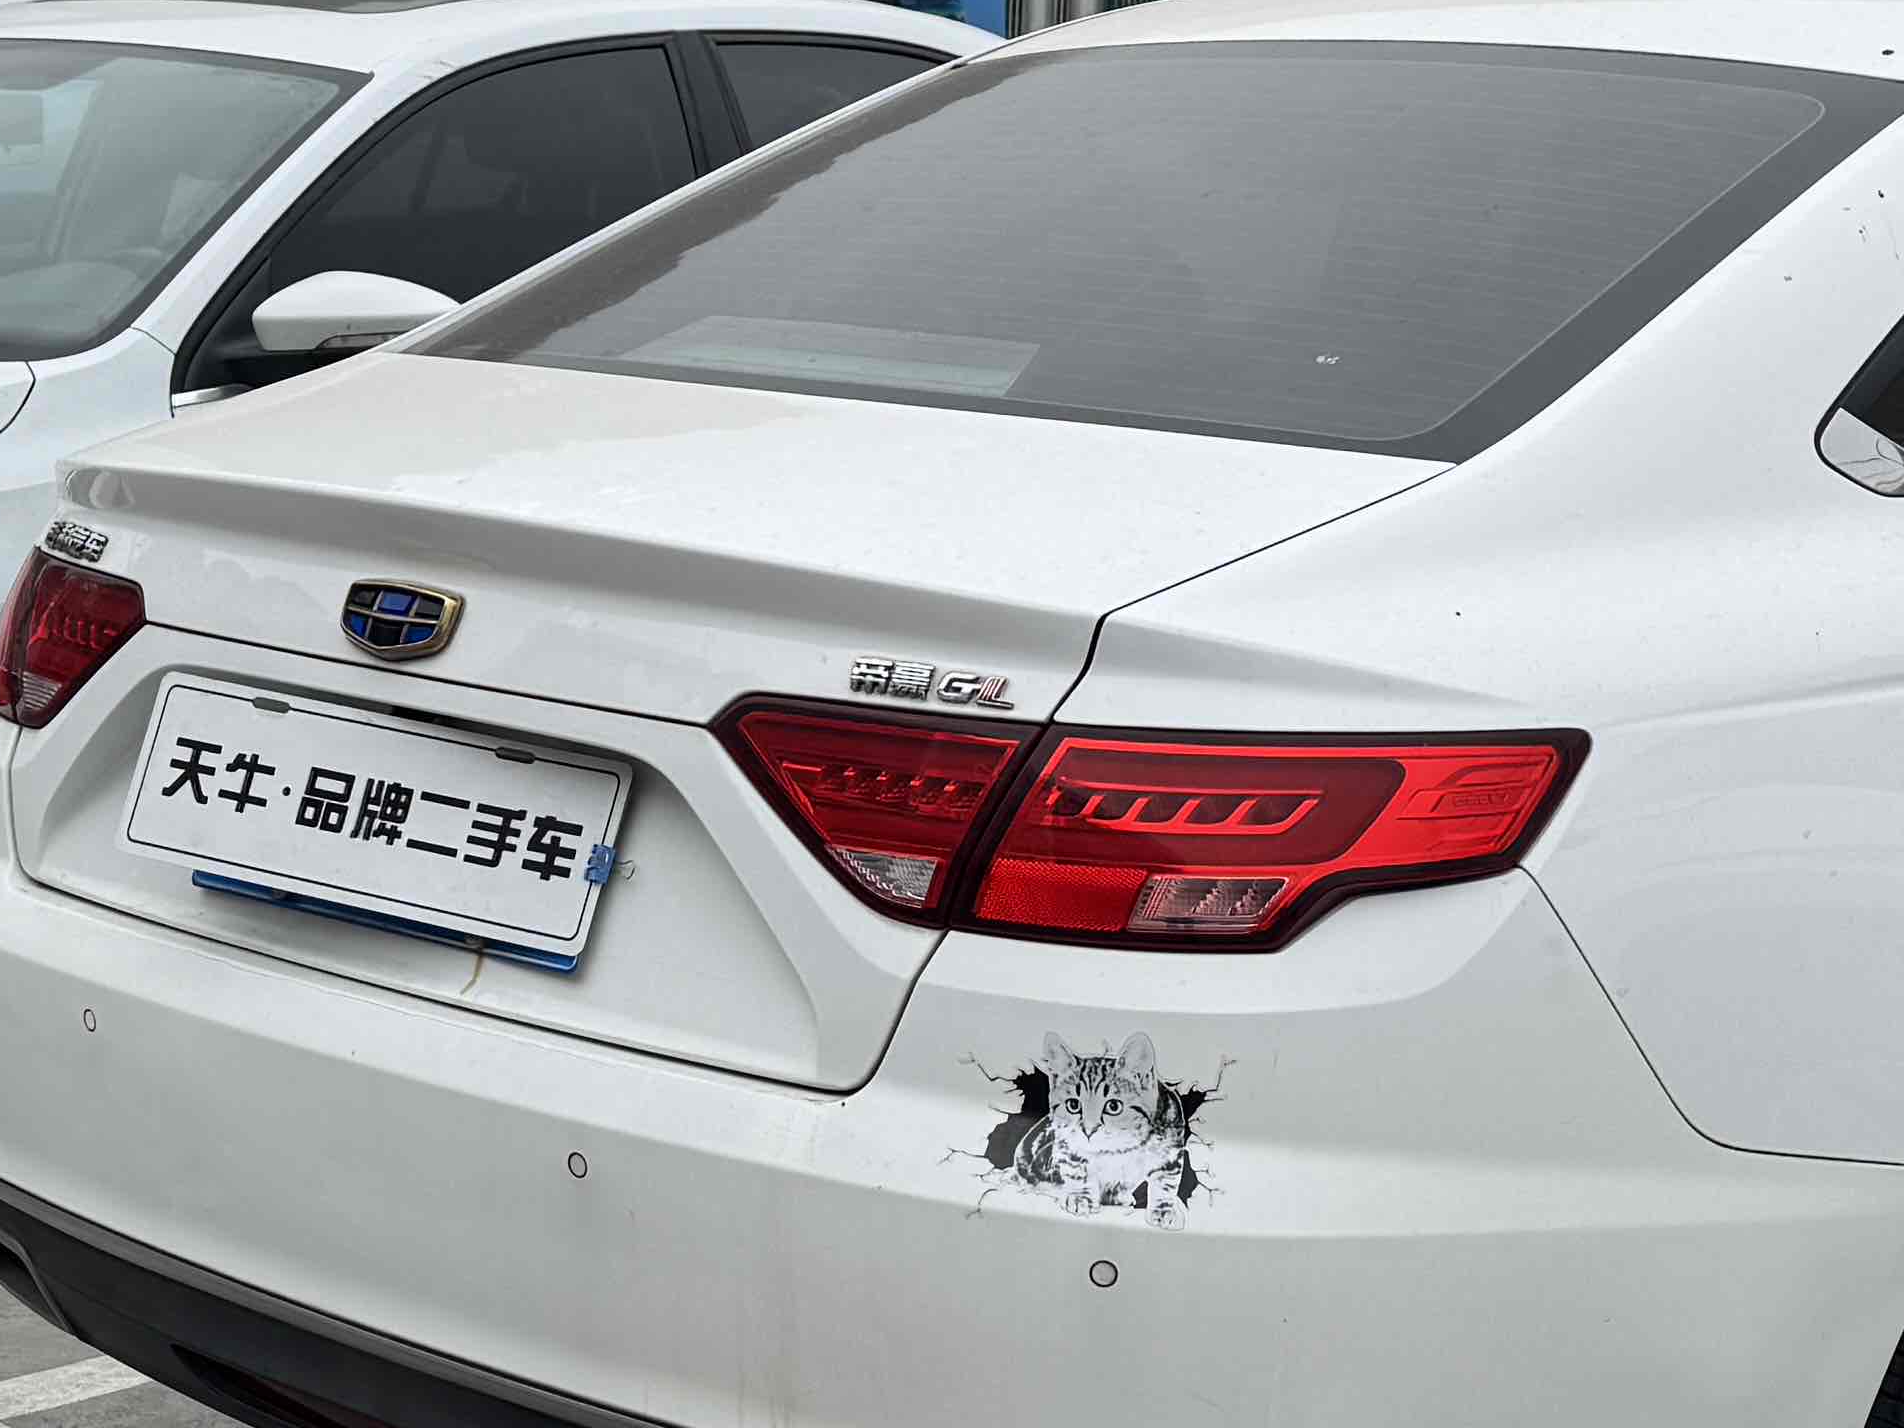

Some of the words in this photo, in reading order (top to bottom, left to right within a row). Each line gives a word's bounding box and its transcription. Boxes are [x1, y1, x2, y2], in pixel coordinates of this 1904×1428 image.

[849, 656, 936, 701] 帝豪
[936, 670, 1015, 711] GL
[160, 735, 586, 883] 天牛·品牌二手车
